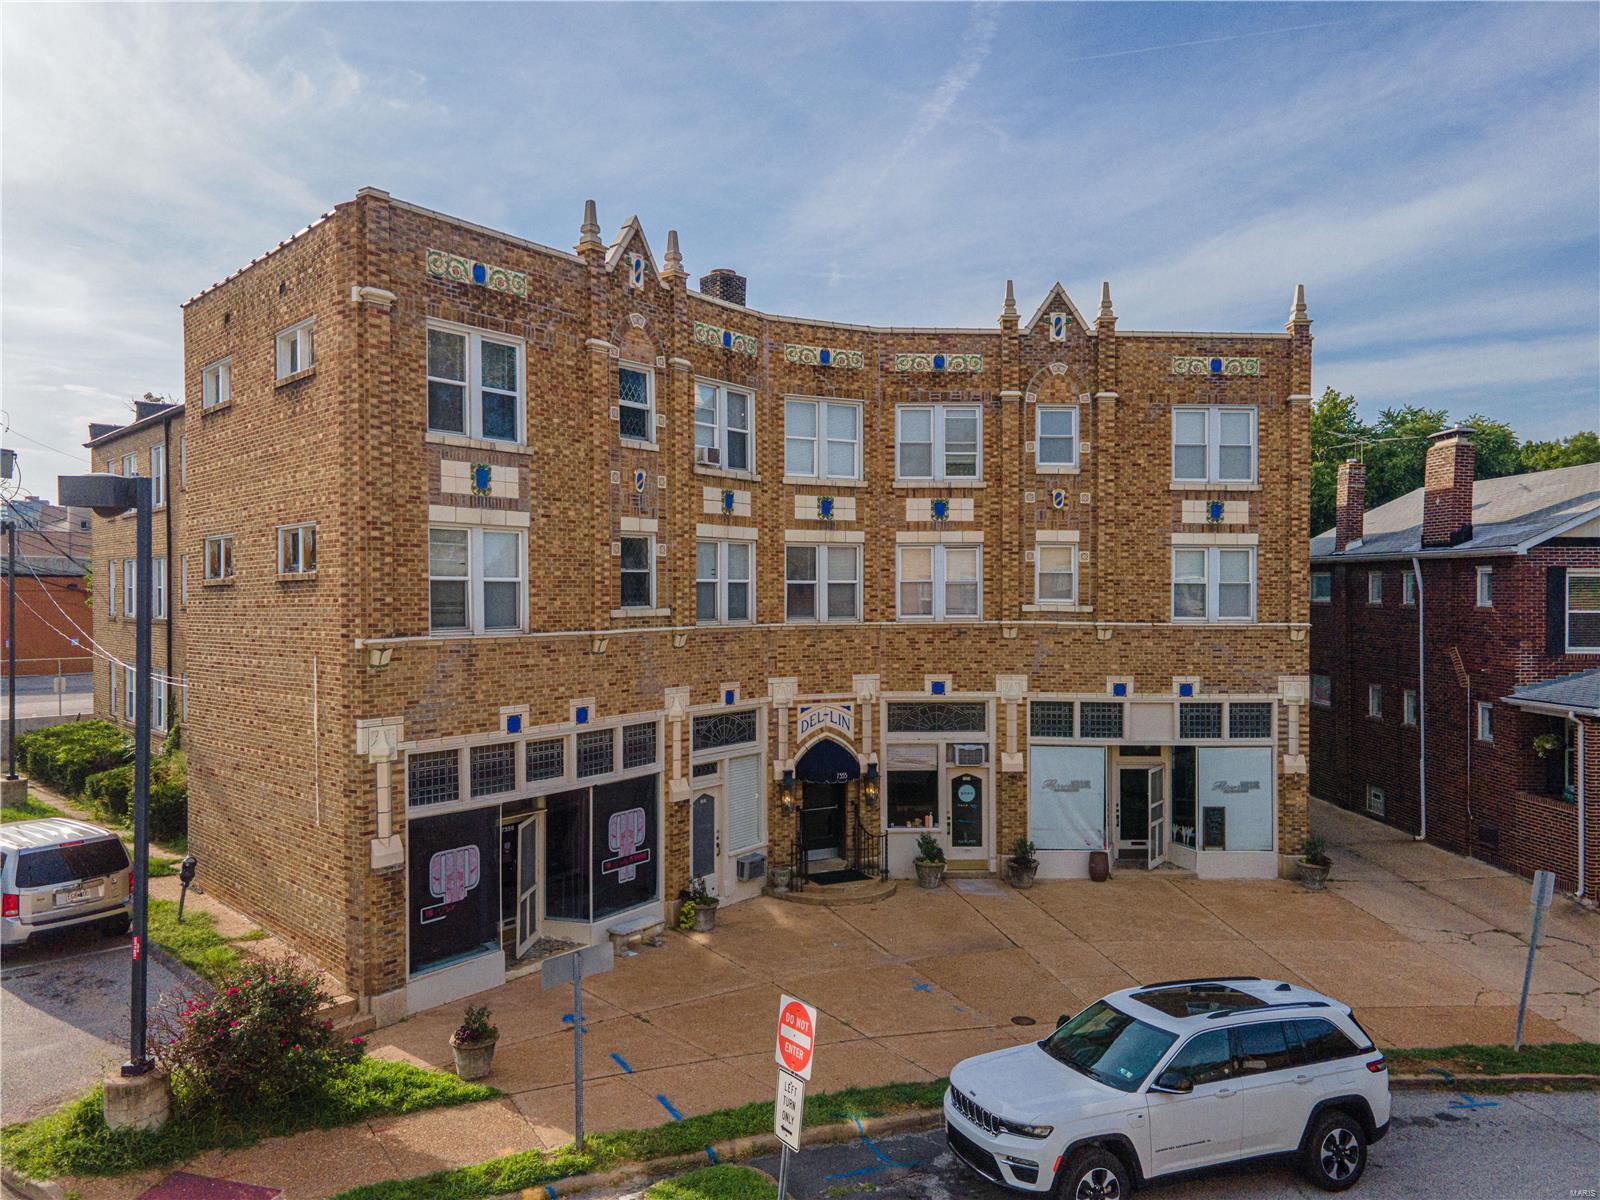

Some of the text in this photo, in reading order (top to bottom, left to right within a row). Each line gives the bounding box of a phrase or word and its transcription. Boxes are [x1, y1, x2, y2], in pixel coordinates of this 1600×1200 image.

[801, 711, 851, 734] DEL-LIN
[785, 1012, 809, 1032] DO NOT
[785, 1042, 804, 1060] ENTER
[784, 1081, 797, 1096] LEFT
[783, 1095, 796, 1111] TURN
[781, 1110, 795, 1125] ONLY
